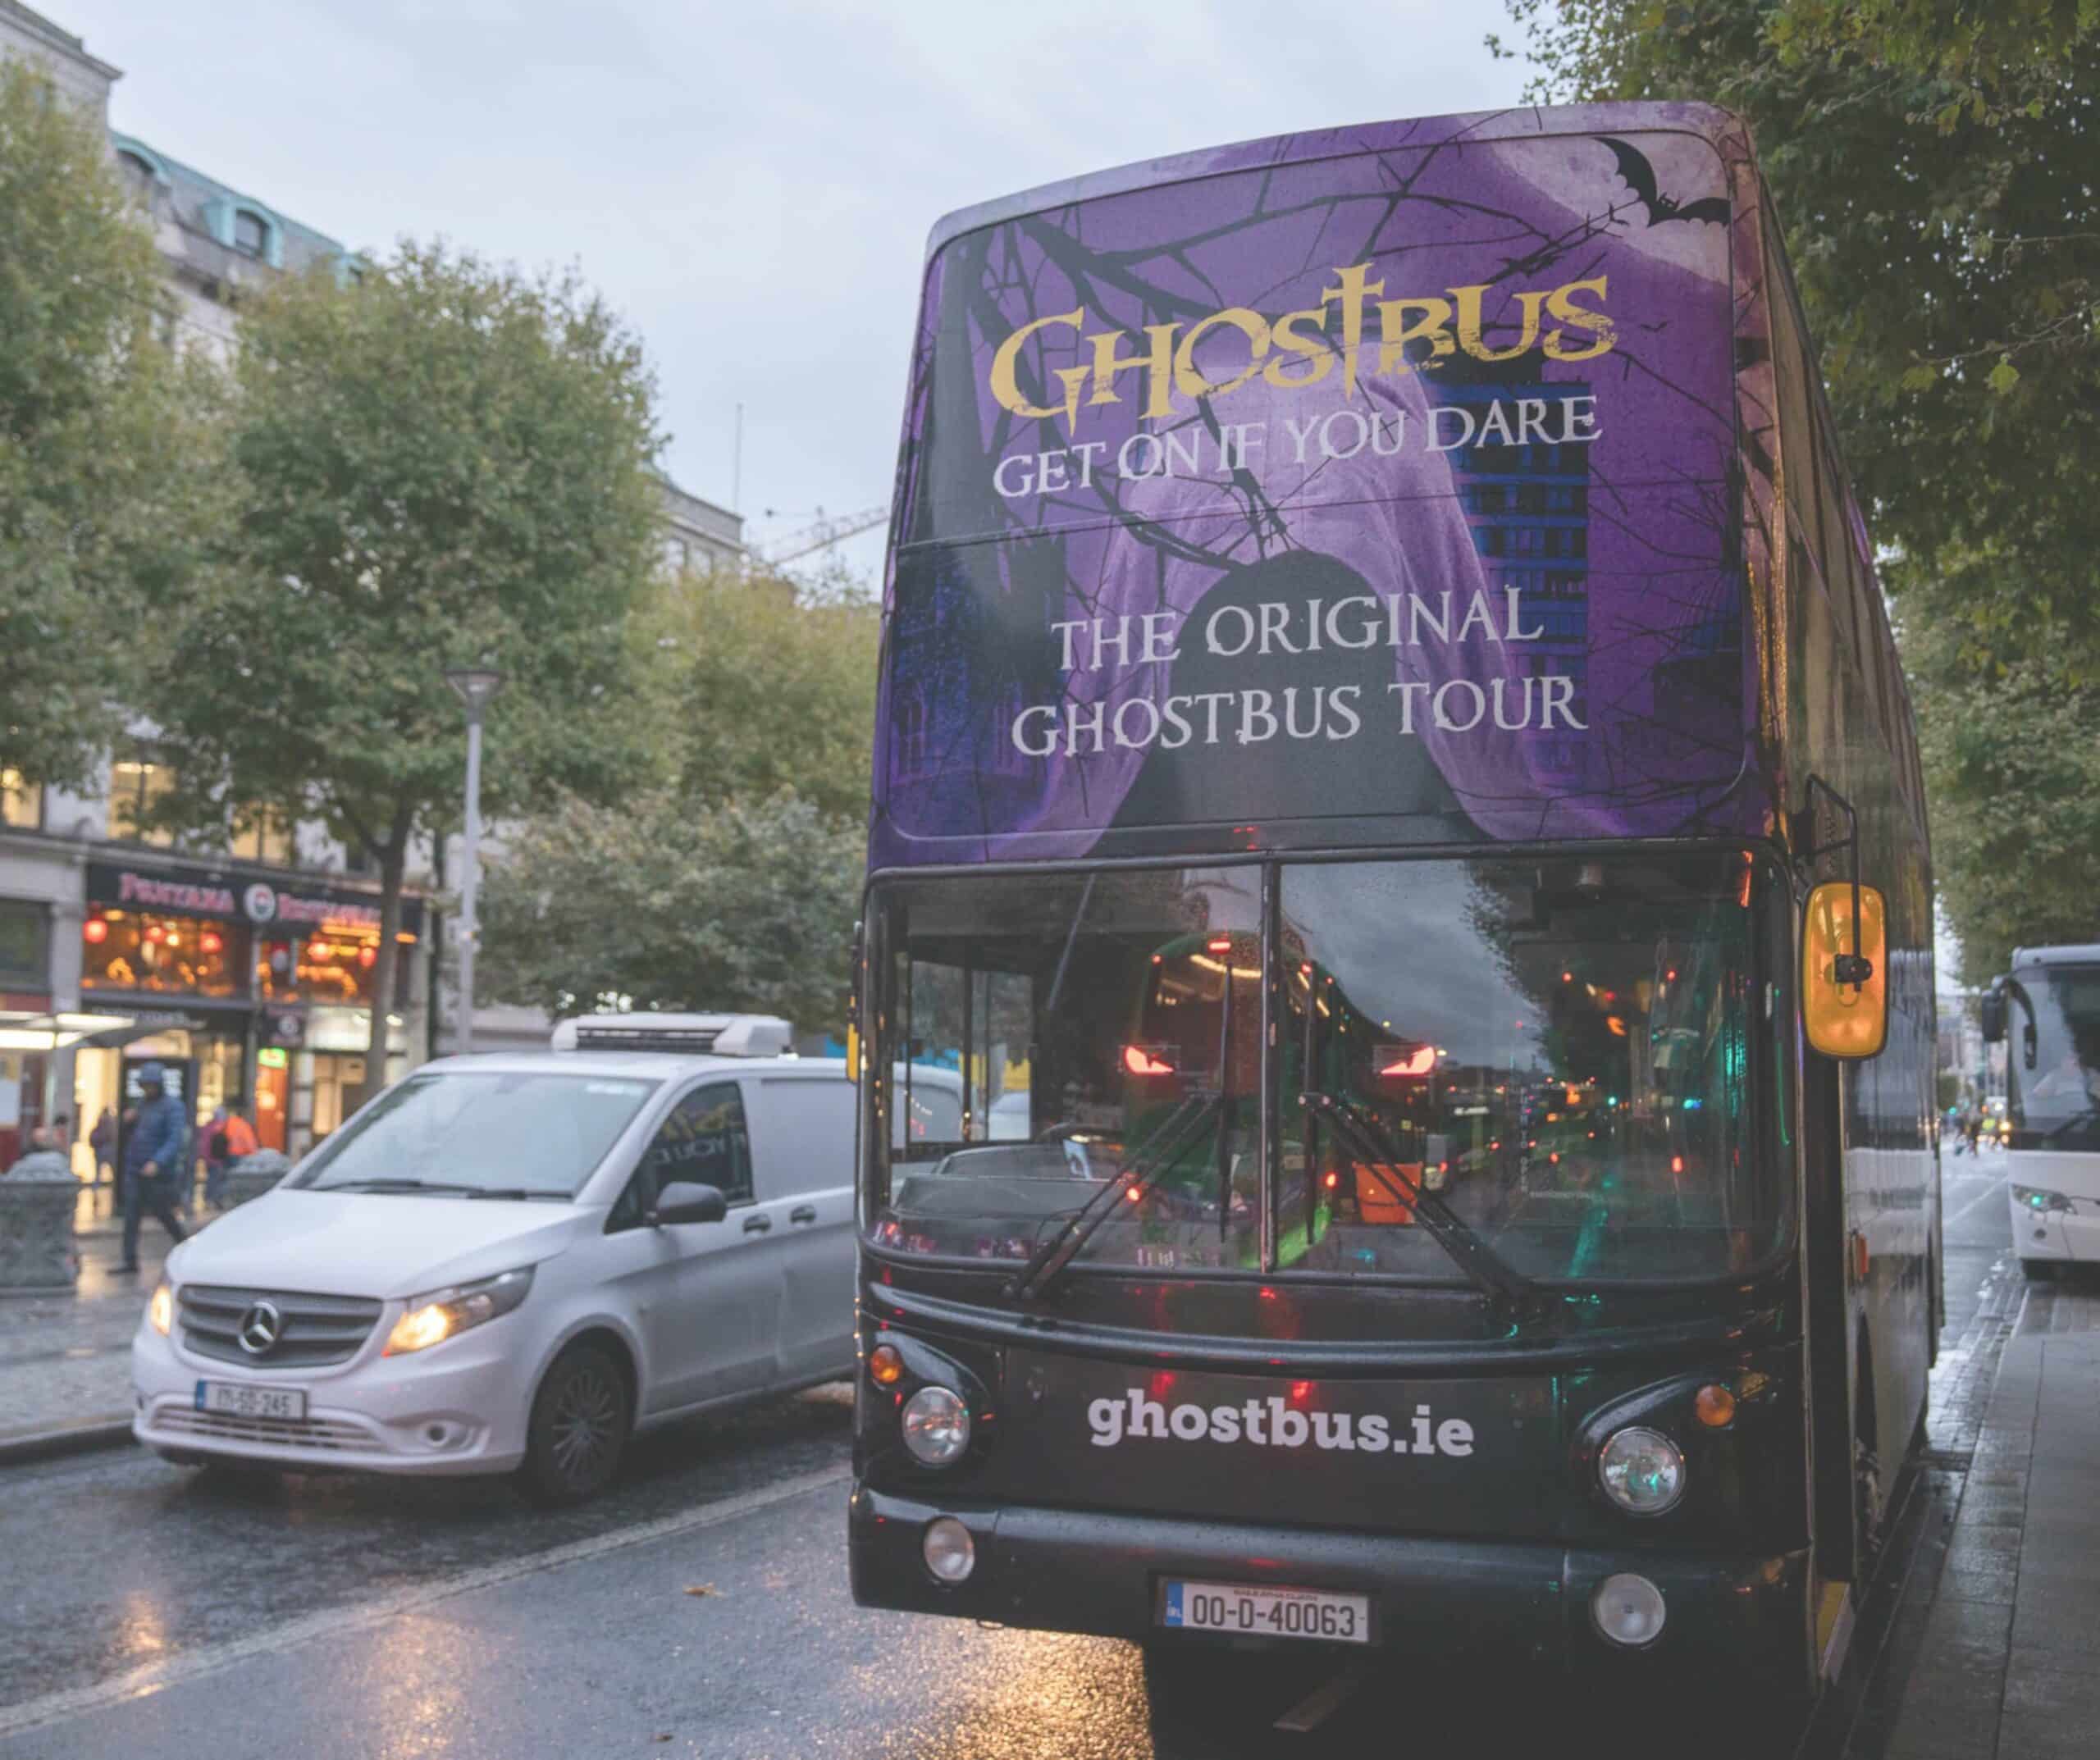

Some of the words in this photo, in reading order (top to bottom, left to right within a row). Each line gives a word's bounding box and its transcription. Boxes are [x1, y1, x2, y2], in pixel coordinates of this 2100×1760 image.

[989, 262, 1618, 437] GHOSTBUS
[993, 442, 1107, 498] GET
[1118, 430, 1202, 481] ON
[1218, 421, 1266, 471] IF
[1285, 412, 1408, 460] YOU
[1424, 394, 1604, 453] DARE
[1050, 612, 1180, 672] THE
[1205, 583, 1544, 657] ORIGINAL
[1011, 685, 1362, 759] GHOSTBUS
[1387, 676, 1588, 736] TOUR
[1087, 1389, 1475, 1458] ghostbus.ie
[1193, 1594, 1354, 1636] 00-D-40063
